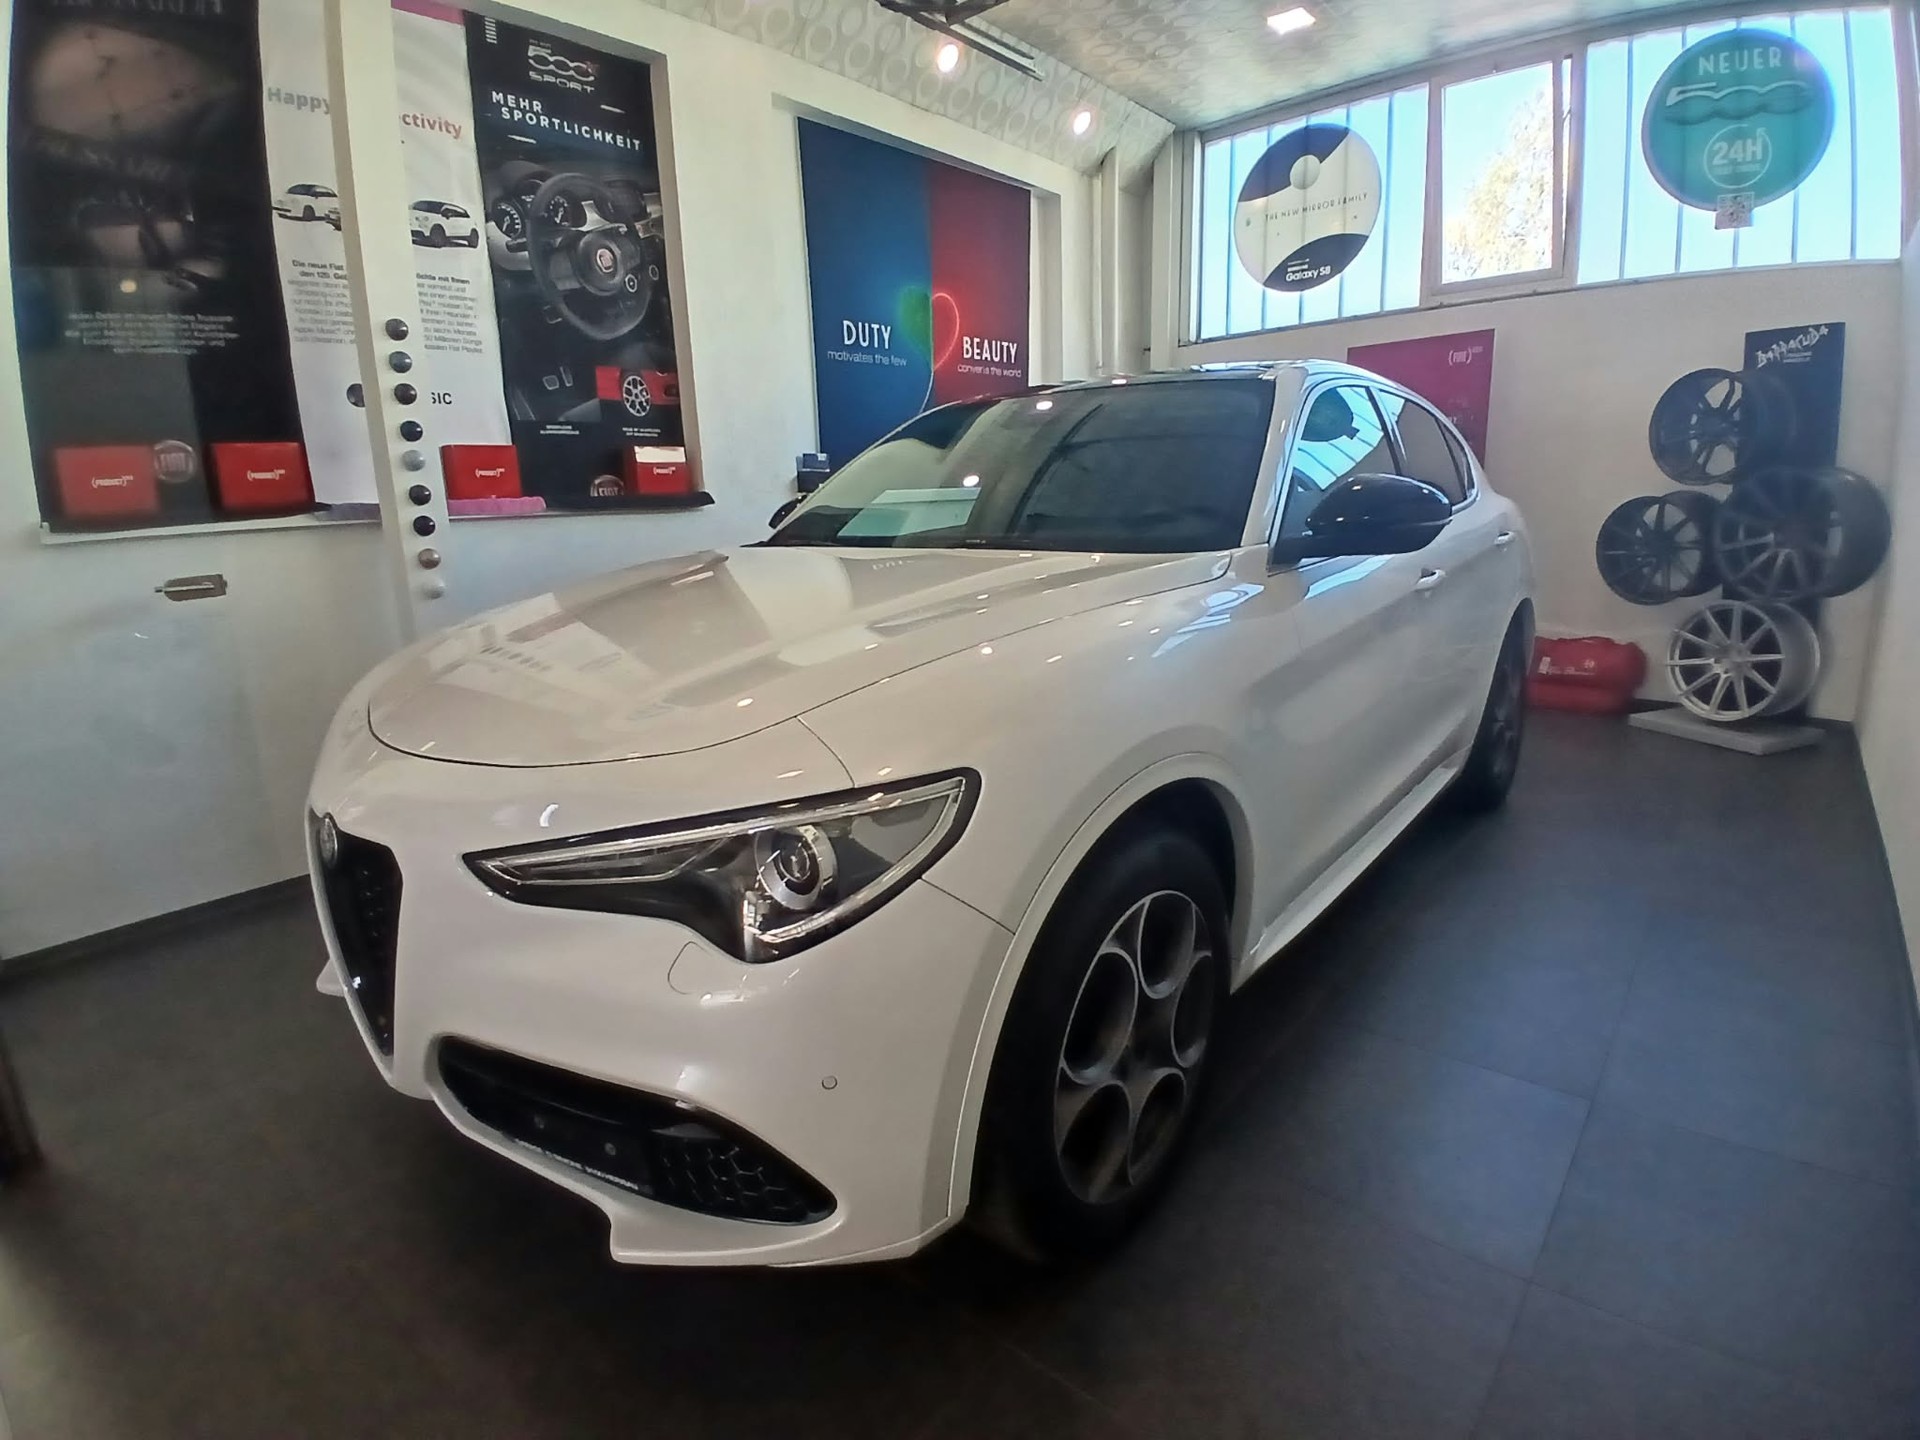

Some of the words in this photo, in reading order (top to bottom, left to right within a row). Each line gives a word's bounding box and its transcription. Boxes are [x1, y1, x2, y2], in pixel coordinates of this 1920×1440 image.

[1698, 46, 1782, 76] NEUER
[528, 71, 595, 93] SPORT
[267, 87, 330, 114] Happy
[400, 113, 462, 140] ctivity
[492, 91, 543, 113] MEHR
[501, 107, 641, 151] SPORTLICHKEIT
[1712, 137, 1763, 166] 24H
[1285, 269, 1319, 282] Galaxy
[842, 320, 892, 350] DUTY
[827, 350, 874, 363] motivates
[874, 353, 890, 366] the
[890, 355, 908, 366] few
[962, 335, 1018, 364] BEAUTY
[1002, 368, 1022, 377] world
[430, 391, 453, 405] SIC
